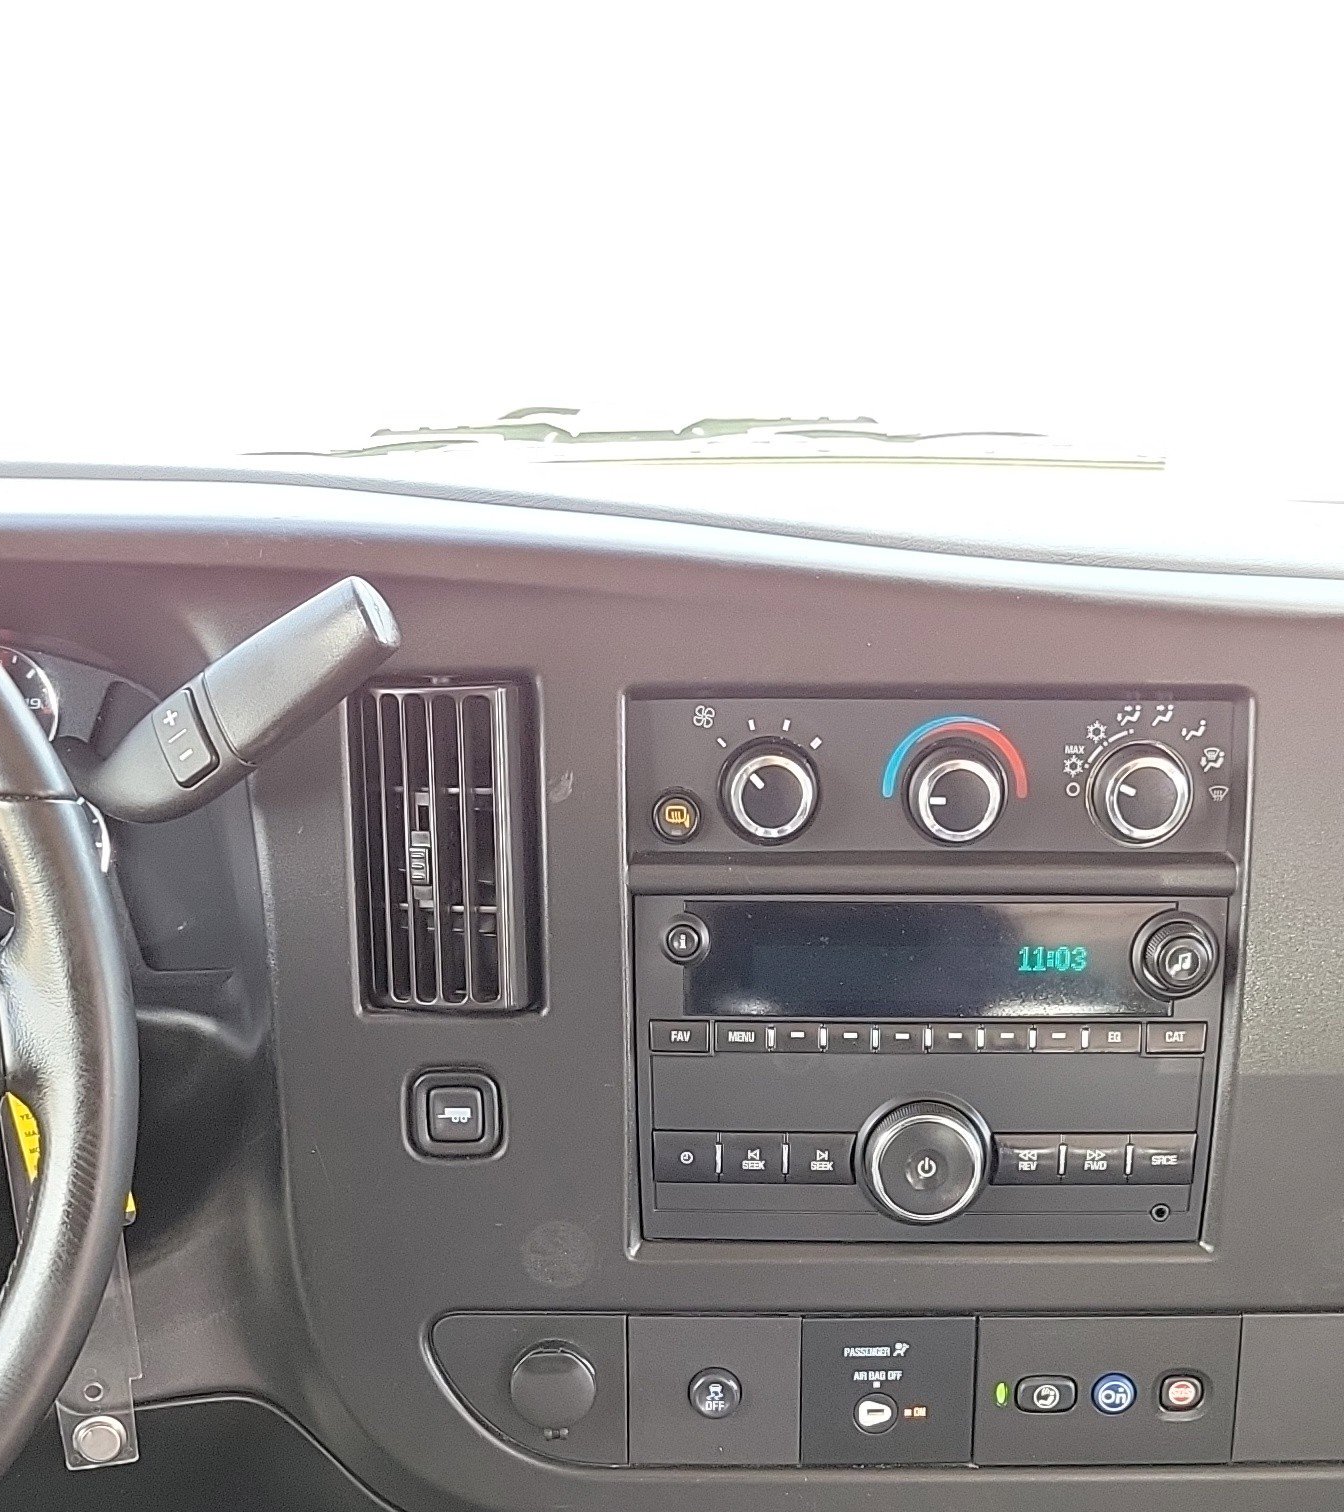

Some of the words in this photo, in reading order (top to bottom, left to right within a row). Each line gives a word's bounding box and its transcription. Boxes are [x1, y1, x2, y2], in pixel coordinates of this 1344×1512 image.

[1065, 745, 1085, 754] MAX
[1018, 946, 1087, 971] 11:03
[671, 1030, 691, 1042] FAV
[728, 1031, 755, 1042] MENU
[1107, 1031, 1122, 1043] EQ
[1165, 1031, 1186, 1043] CAT
[742, 1160, 765, 1170] SEEK
[810, 1161, 834, 1171] SEEK
[1018, 1161, 1038, 1171] REV
[1084, 1161, 1108, 1171] FWD
[843, 1347, 891, 1357] PASSENGER
[853, 1371, 868, 1381] AIR
[868, 1371, 886, 1380] BAG
[887, 1370, 903, 1380] OFF
[705, 1401, 725, 1411] OFF
